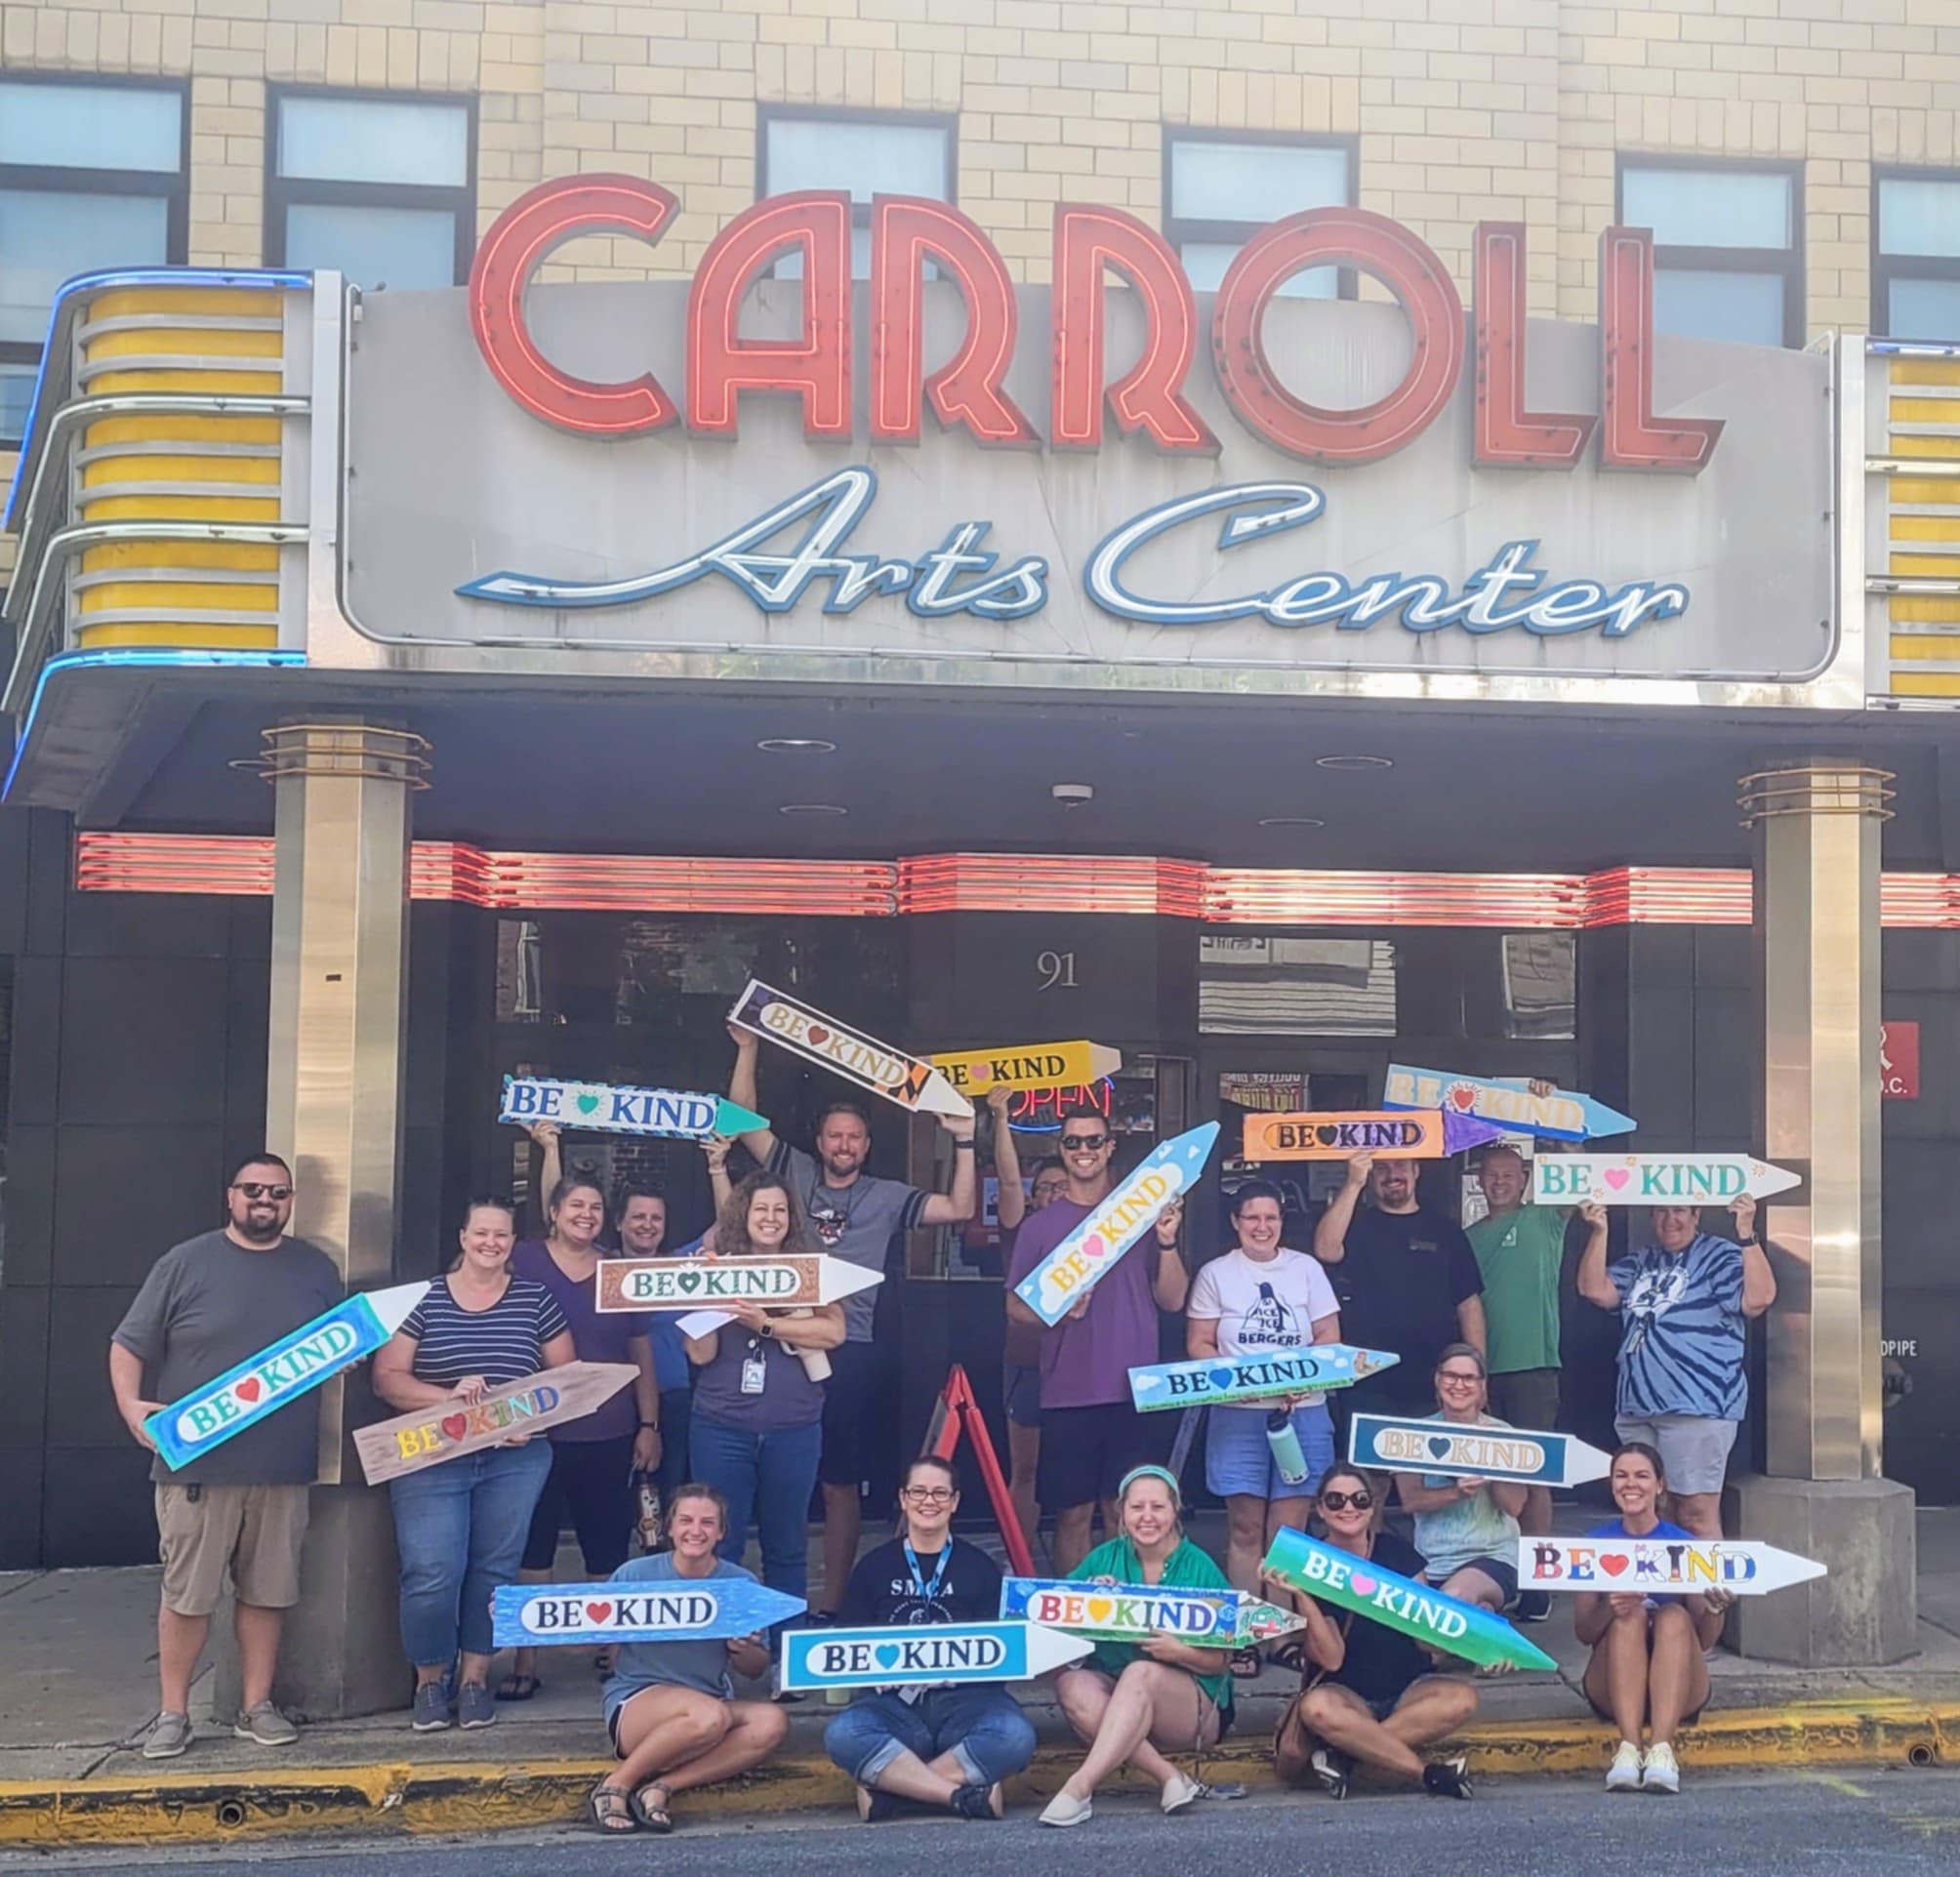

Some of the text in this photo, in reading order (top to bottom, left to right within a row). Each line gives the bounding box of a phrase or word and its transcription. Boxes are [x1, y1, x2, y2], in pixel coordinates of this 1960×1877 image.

[470, 172, 1726, 475] CARROLL
[455, 465, 1690, 636] Arts Center
[1038, 951, 1079, 992] 91
[765, 1005, 907, 1087] BE KIND
[992, 1055, 1065, 1081] KIND
[1881, 1078, 1907, 1093] .C.
[510, 1084, 715, 1130] BE KIND
[1389, 1074, 1584, 1132] BE KIND
[1279, 1122, 1422, 1148] BE KIND
[1540, 1163, 1746, 1196] BE KIND
[1049, 1174, 1168, 1291] BE KIND
[633, 1269, 796, 1296] BE KIND
[1238, 1332, 1301, 1346] BERGERS
[185, 1326, 352, 1436] BE KIND
[1167, 1359, 1319, 1395] BE KIND
[395, 1386, 559, 1460] BE KIND
[1382, 1431, 1541, 1470] BE KIND
[1531, 1542, 1756, 1583] BE KIND
[536, 1597, 714, 1628] BE KIND
[1038, 1595, 1212, 1631] BE KIND
[1302, 1550, 1467, 1638] BE KIND
[822, 1639, 1000, 1672] BE KIND
